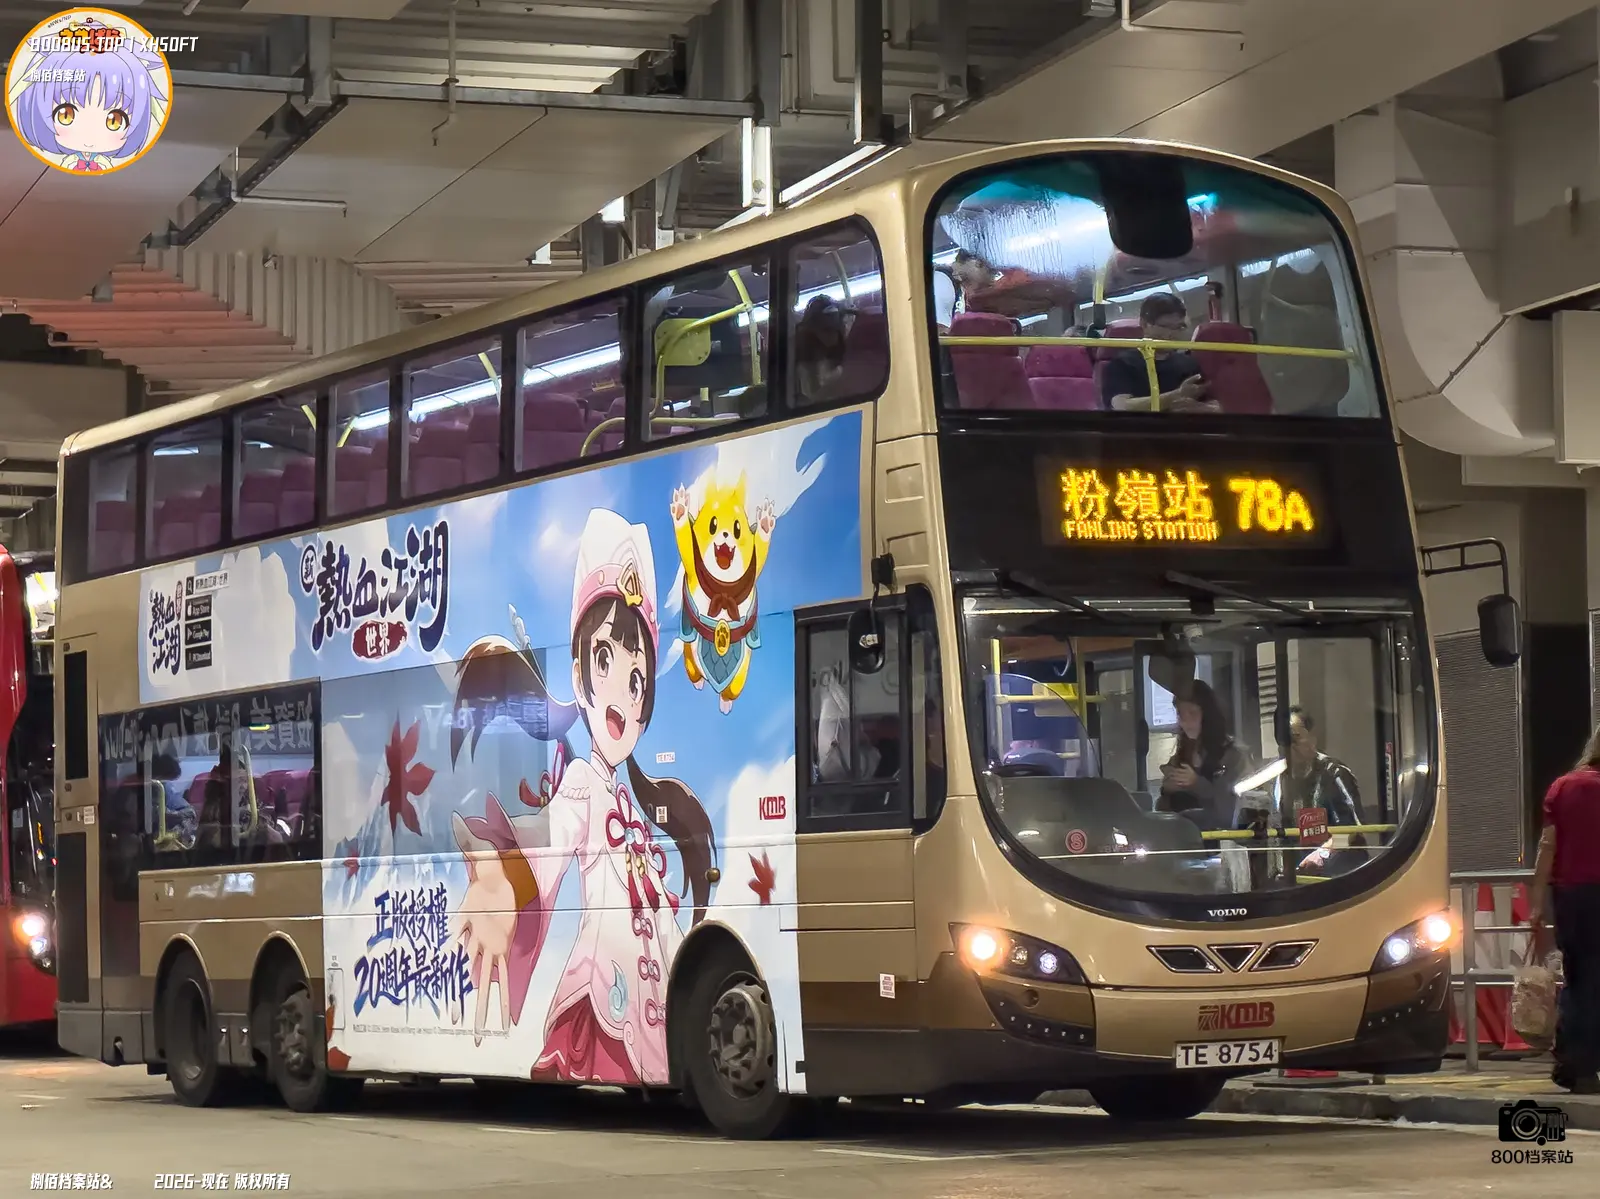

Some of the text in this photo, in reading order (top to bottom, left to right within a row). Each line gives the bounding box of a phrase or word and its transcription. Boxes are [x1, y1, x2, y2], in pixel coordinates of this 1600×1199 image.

[1060, 468, 1213, 520] 粉嶺站
[1226, 478, 1315, 532] 78A
[1063, 520, 1219, 541] FANLING STATION
[312, 521, 449, 651] 熱血江湖
[365, 622, 390, 657] 世界
[759, 796, 787, 820] KMB
[367, 882, 452, 952] 正版授權
[1207, 907, 1248, 917] VOLVO
[353, 942, 474, 1024] 20週年最新作
[1220, 1001, 1275, 1029] KMB
[1181, 1041, 1275, 1066] TE 8754
